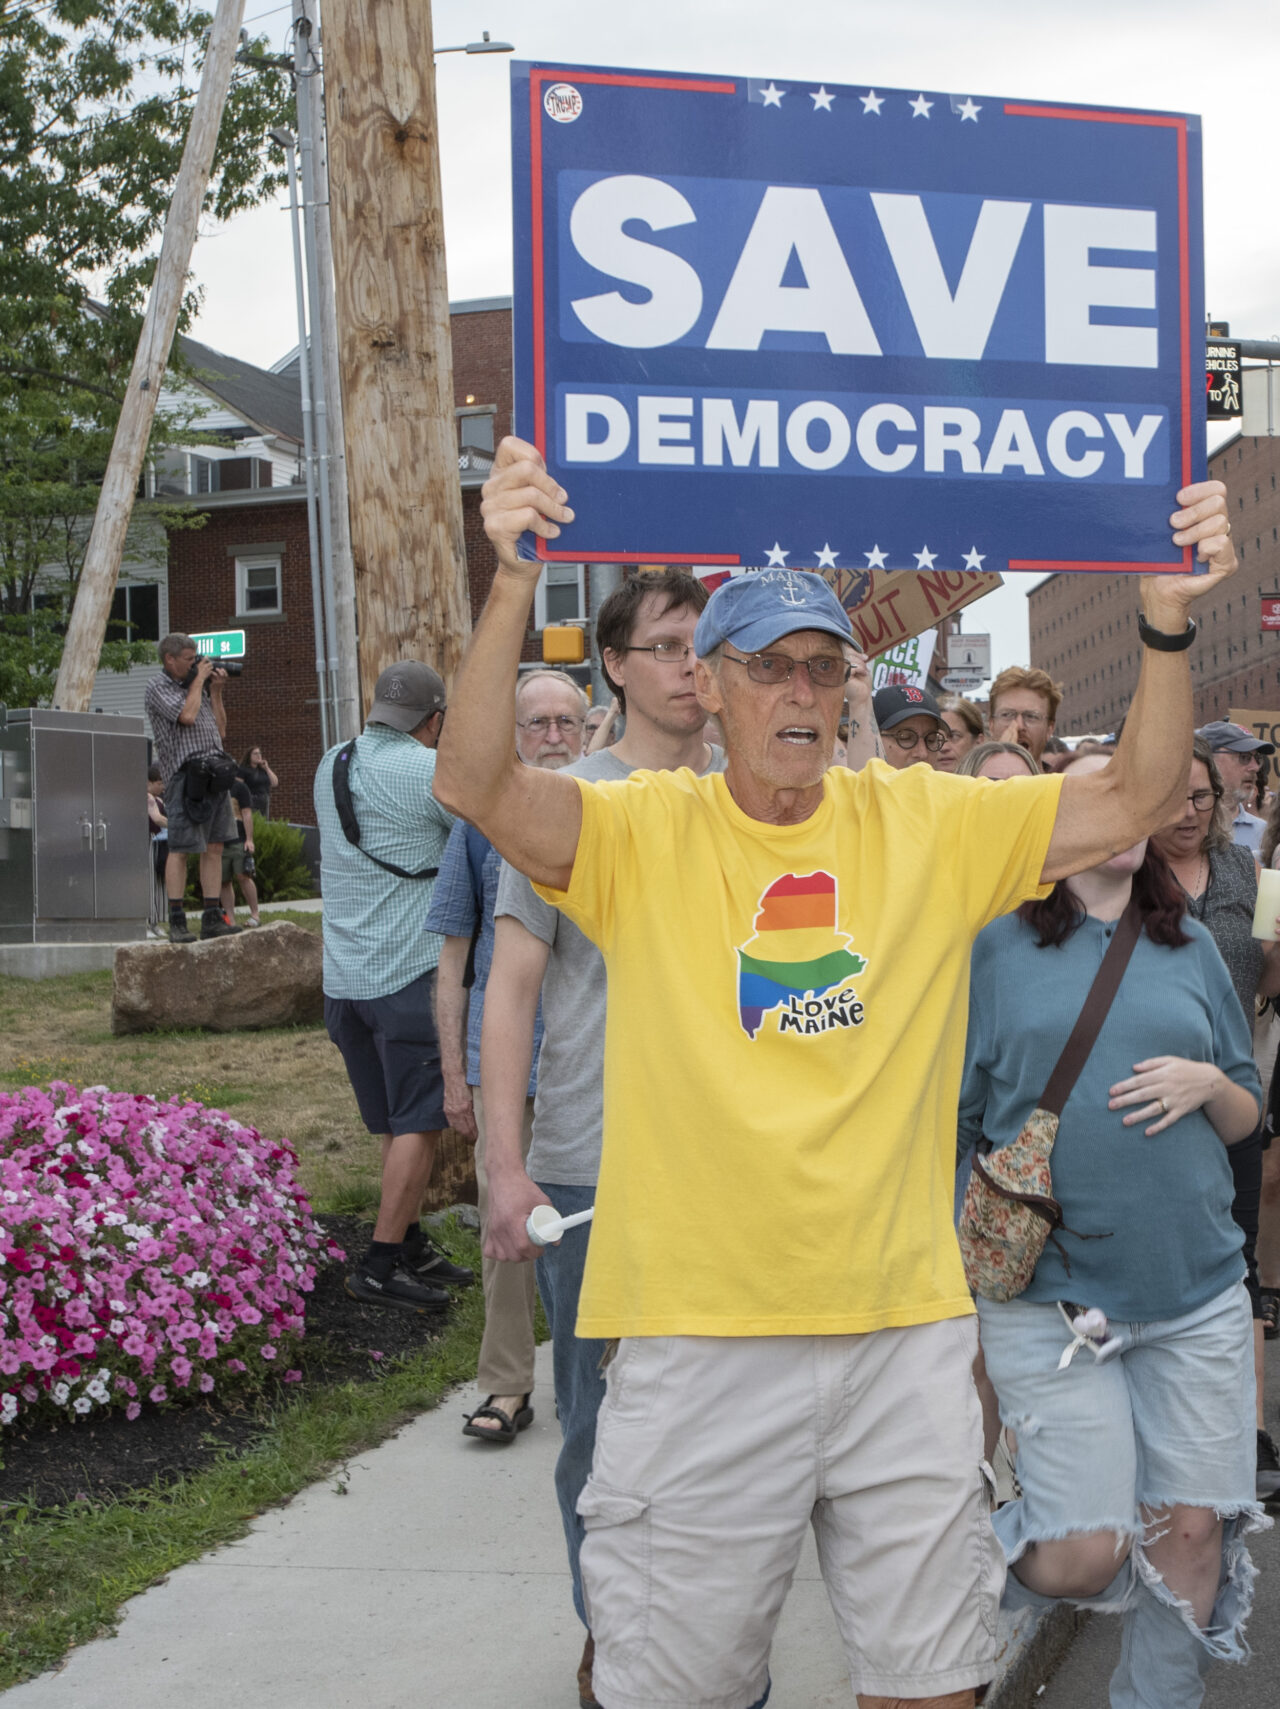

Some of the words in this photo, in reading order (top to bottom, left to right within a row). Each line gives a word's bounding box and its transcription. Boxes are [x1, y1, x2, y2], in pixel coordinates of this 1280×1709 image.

[569, 173, 1159, 369] SAVE
[1206, 346, 1237, 358] URNING
[1205, 359, 1239, 371] EHICLES
[1209, 389, 1222, 401] TO
[564, 392, 1164, 479] DEMOCRACY
[220, 641, 230, 653] St
[901, 687, 924, 703] B
